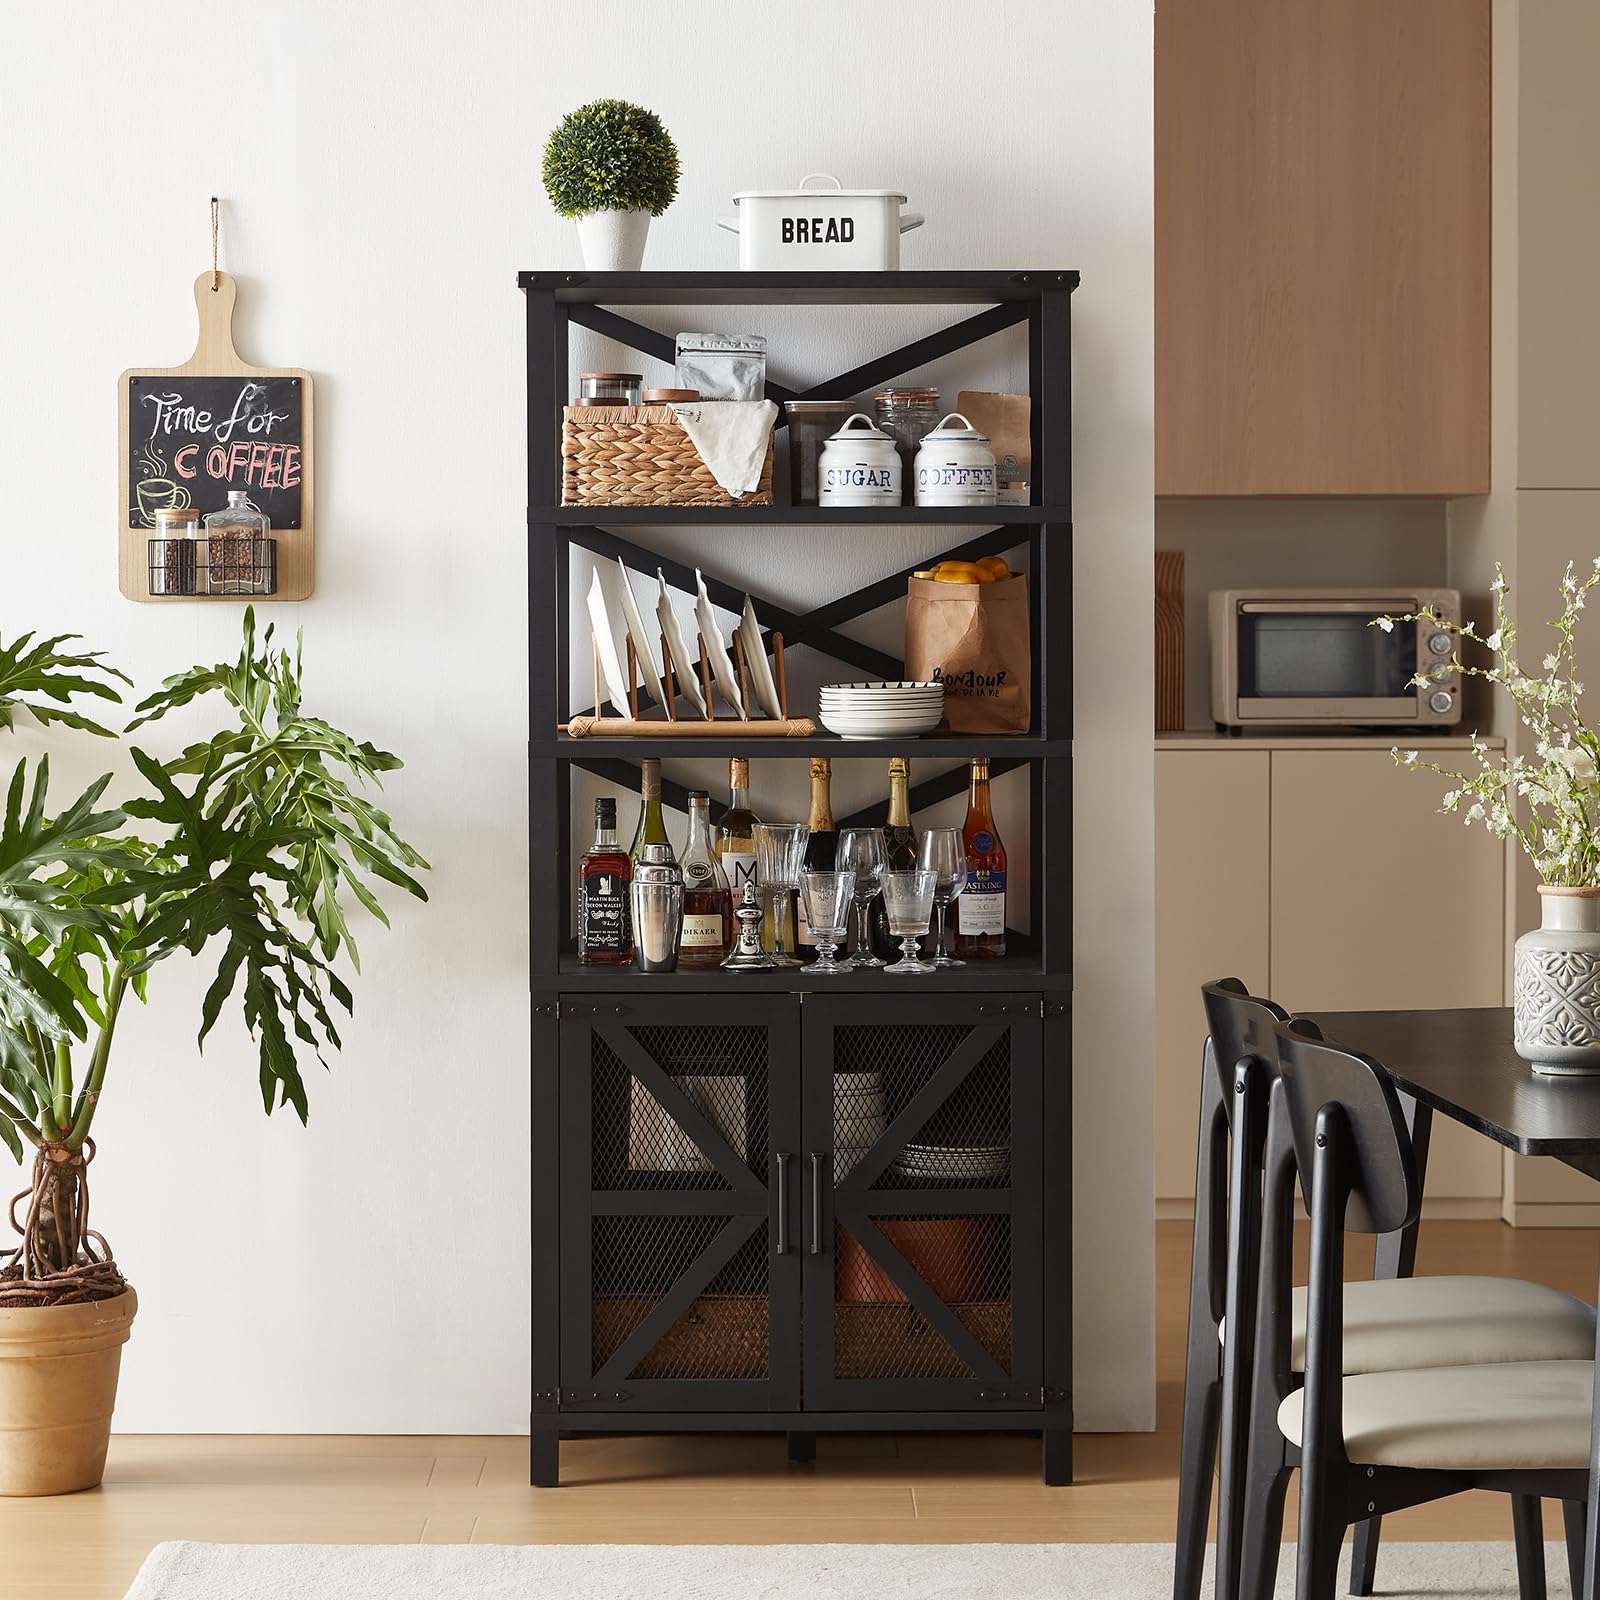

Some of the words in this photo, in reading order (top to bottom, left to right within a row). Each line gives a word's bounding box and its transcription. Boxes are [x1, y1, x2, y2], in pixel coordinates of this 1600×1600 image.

[782, 218, 854, 243] BREAD
[141, 392, 213, 440] Time
[214, 383, 289, 443] for
[827, 469, 891, 487] SUGAR
[919, 468, 993, 486] COFFEE
[732, 860, 760, 888] M
[965, 881, 1002, 890] ASTKING
